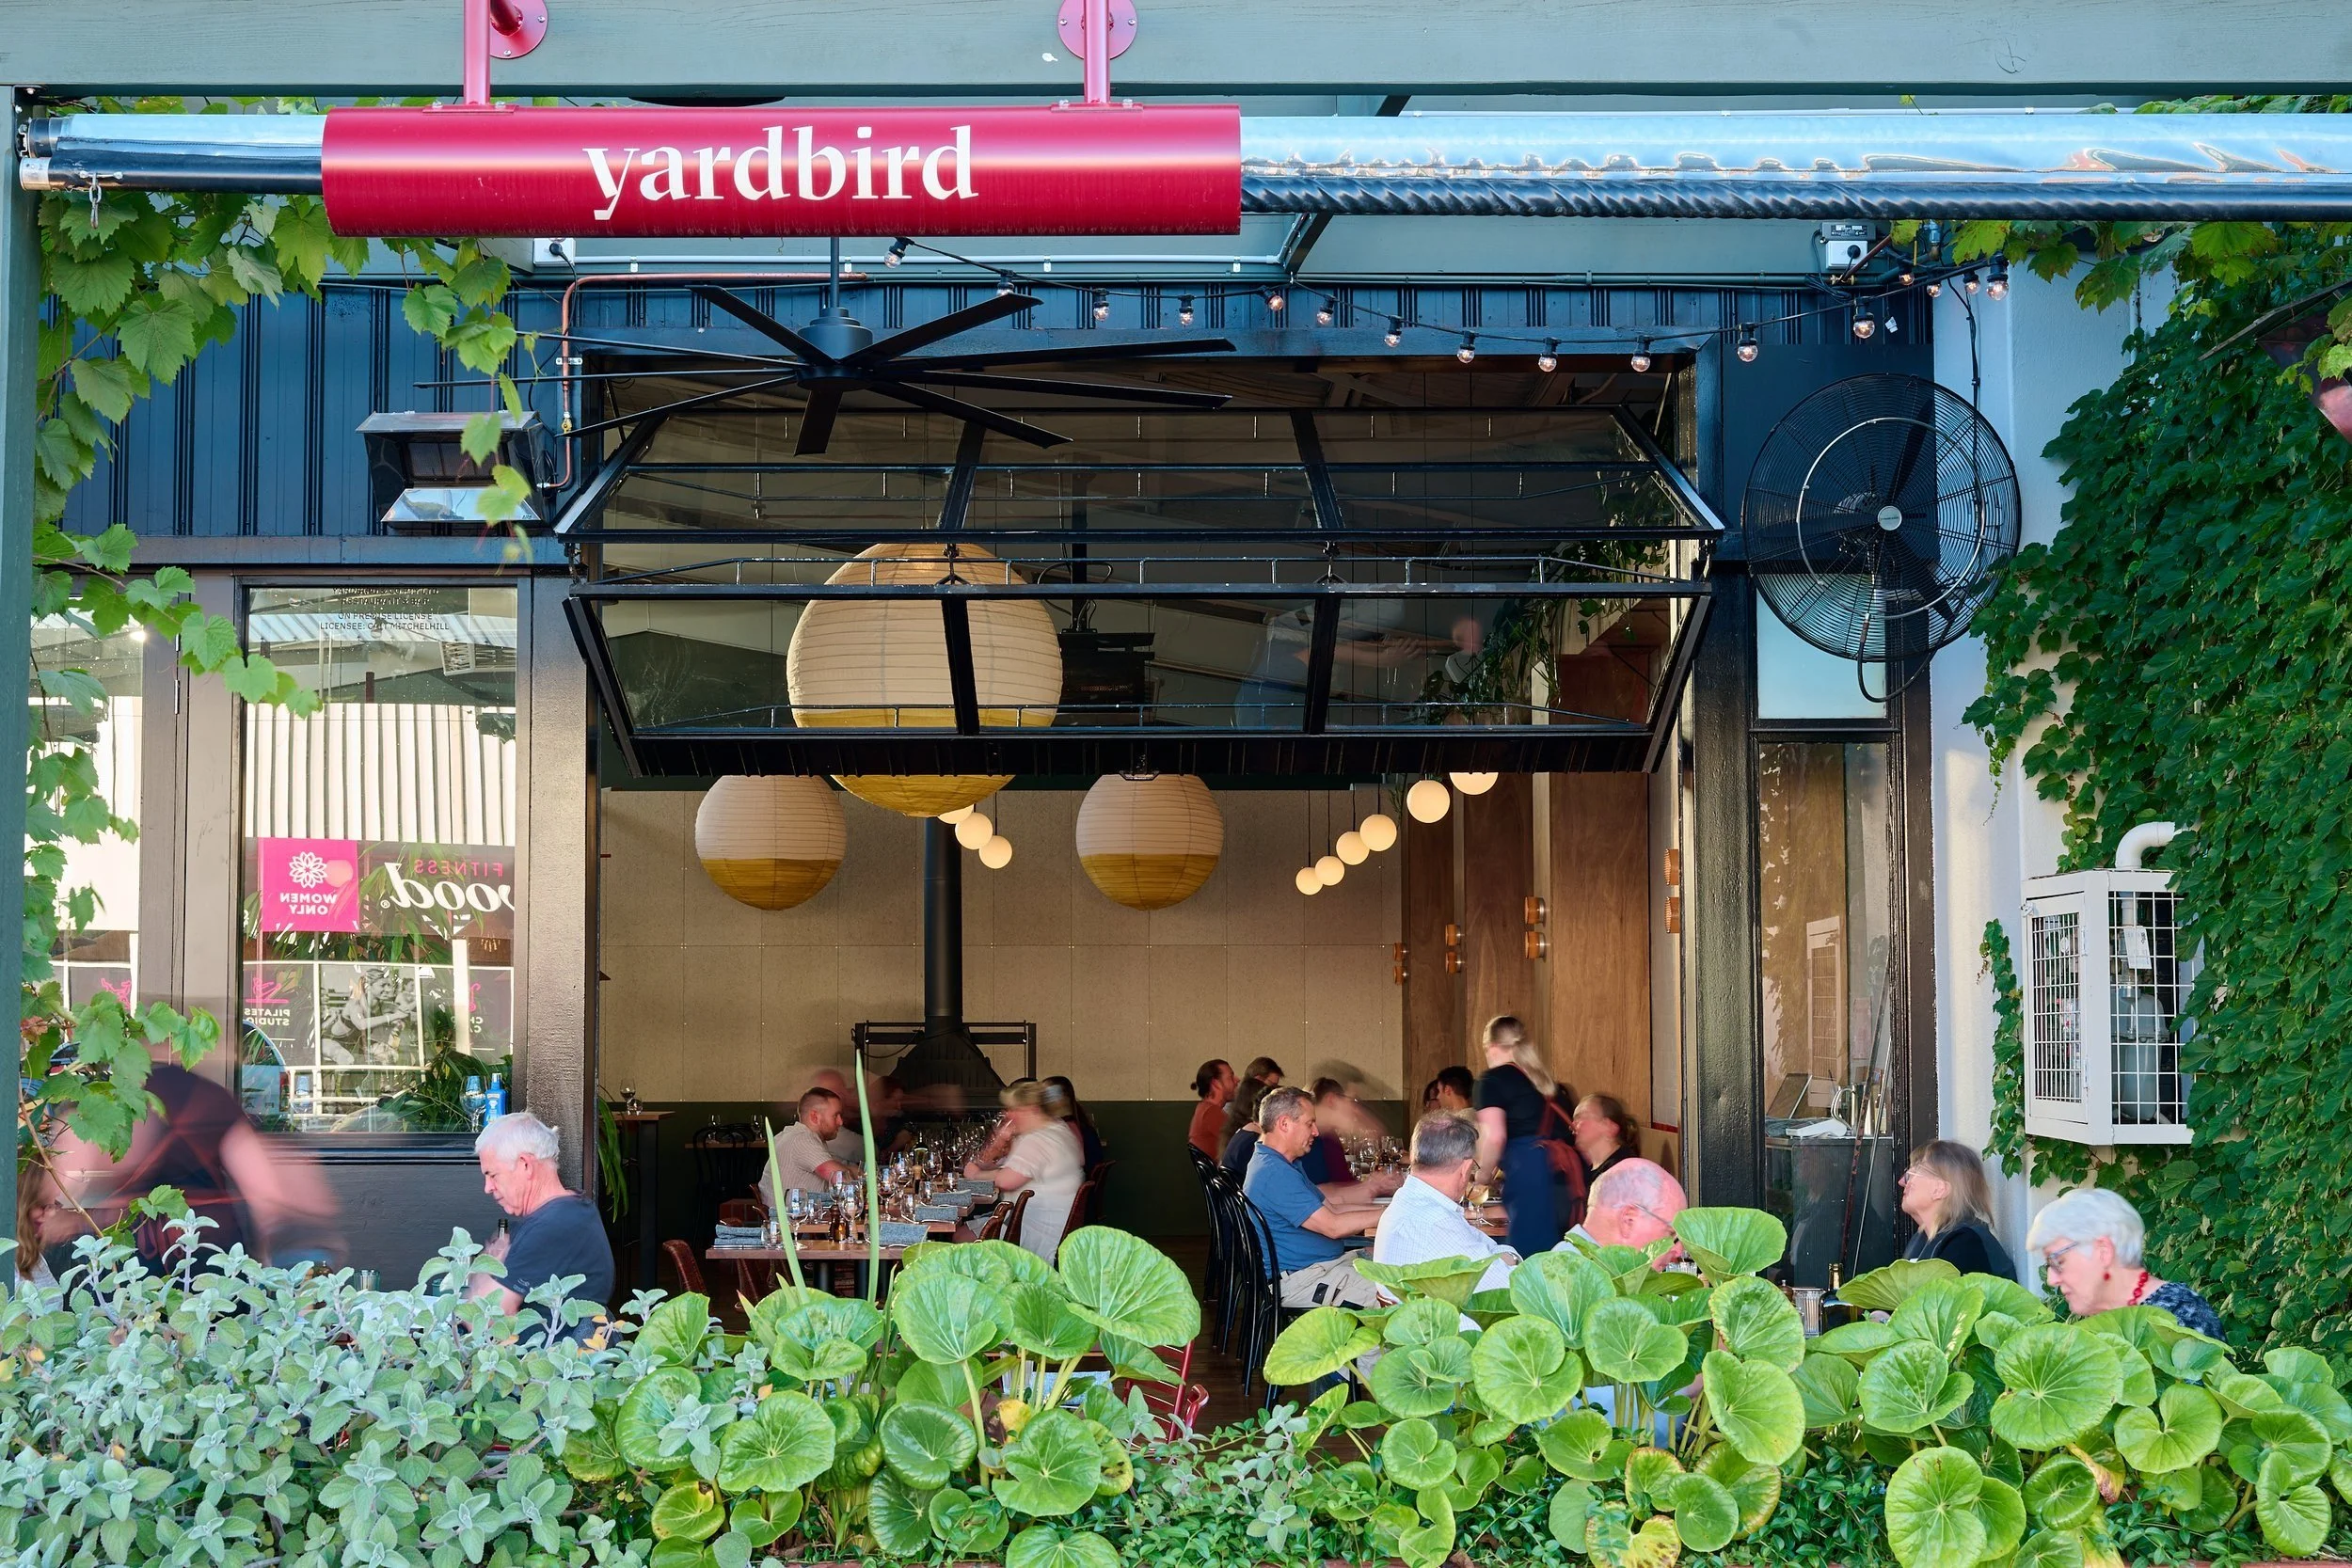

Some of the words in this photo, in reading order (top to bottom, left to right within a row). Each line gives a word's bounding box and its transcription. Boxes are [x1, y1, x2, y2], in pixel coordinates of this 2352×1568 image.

[581, 125, 979, 221] yardbird
[394, 612, 433, 621] LICENSE
[320, 622, 366, 630] LICENSEE:
[390, 622, 450, 630] MITCHELHILL
